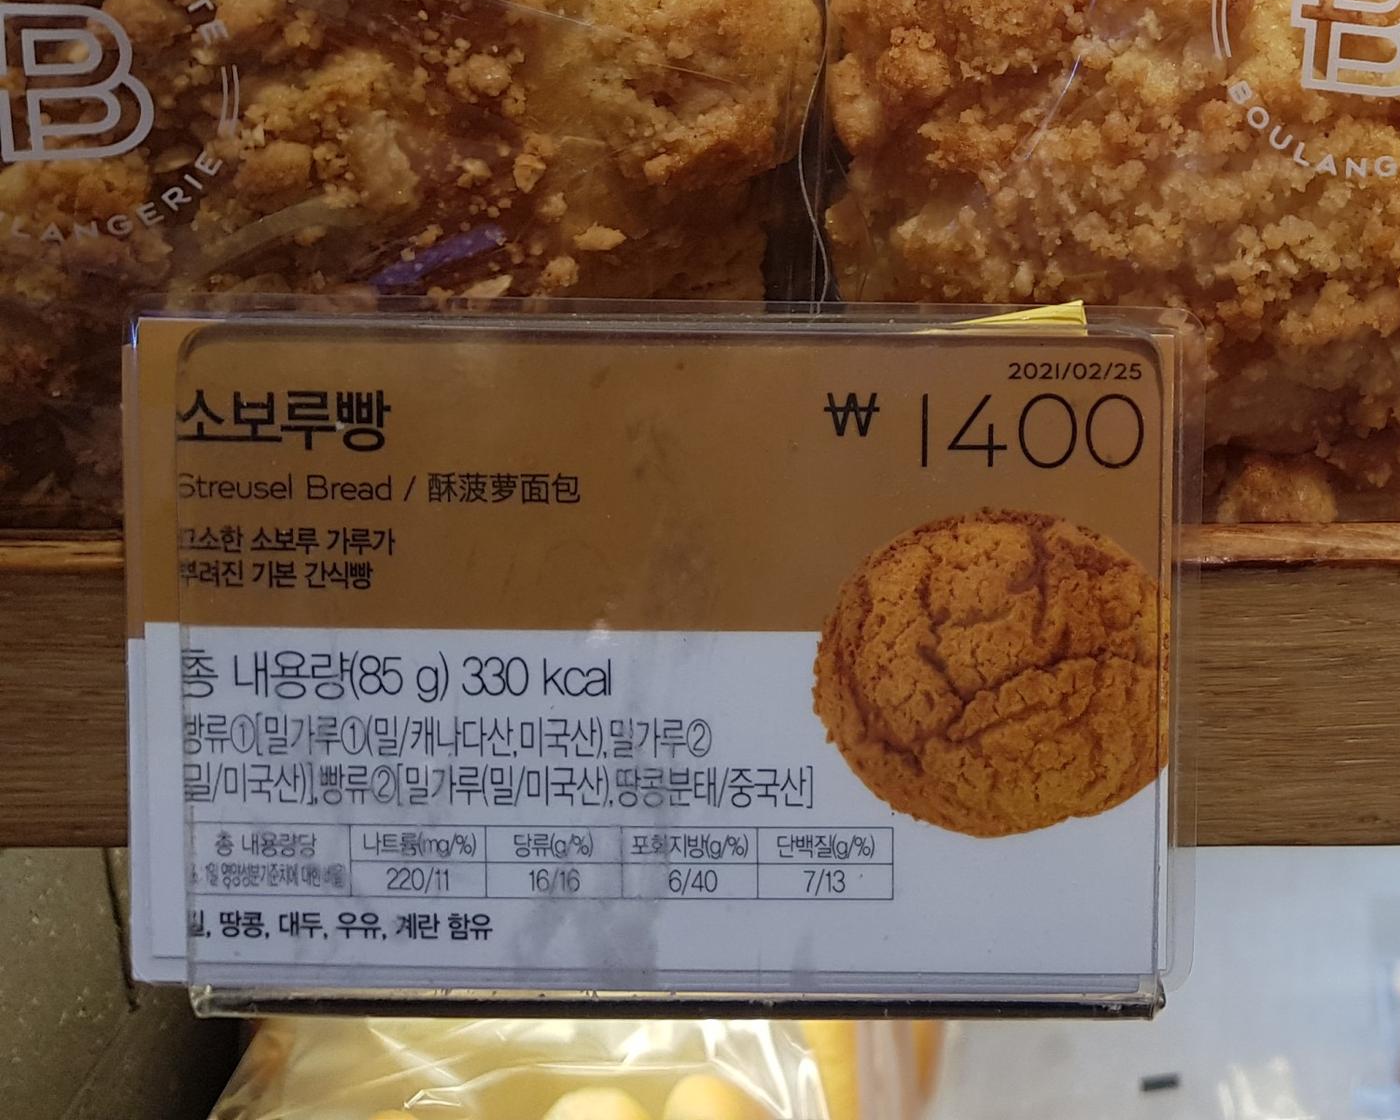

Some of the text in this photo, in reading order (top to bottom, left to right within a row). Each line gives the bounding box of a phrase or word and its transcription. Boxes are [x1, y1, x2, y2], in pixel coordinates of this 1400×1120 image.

[1008, 361, 1143, 381] 2021/02/25
[176, 389, 391, 452] 소보루빵
[920, 392, 1145, 470] 1400
[178, 472, 293, 501] Streusel
[306, 474, 393, 501] Bread
[427, 472, 581, 505] 酥菠萝面包
[251, 526, 319, 555] 소보루
[327, 527, 395, 555] 가루가
[252, 561, 297, 588] 기본
[304, 561, 374, 590] 간식빵
[233, 649, 404, 701] 내용량(85
[416, 651, 449, 703] g)
[462, 655, 530, 697] 330
[543, 657, 613, 697] kcal
[776, 834, 876, 860] 단백질(g/%)
[386, 867, 450, 893] 220/11
[528, 869, 581, 894] 16/16
[668, 869, 718, 896] 6/40
[803, 869, 846, 896] 7/13
[219, 910, 270, 940] 땅콩,
[279, 911, 328, 940] 대두,
[335, 912, 387, 942] 우유,
[396, 913, 440, 941] 계란
[447, 914, 493, 941] 함유
